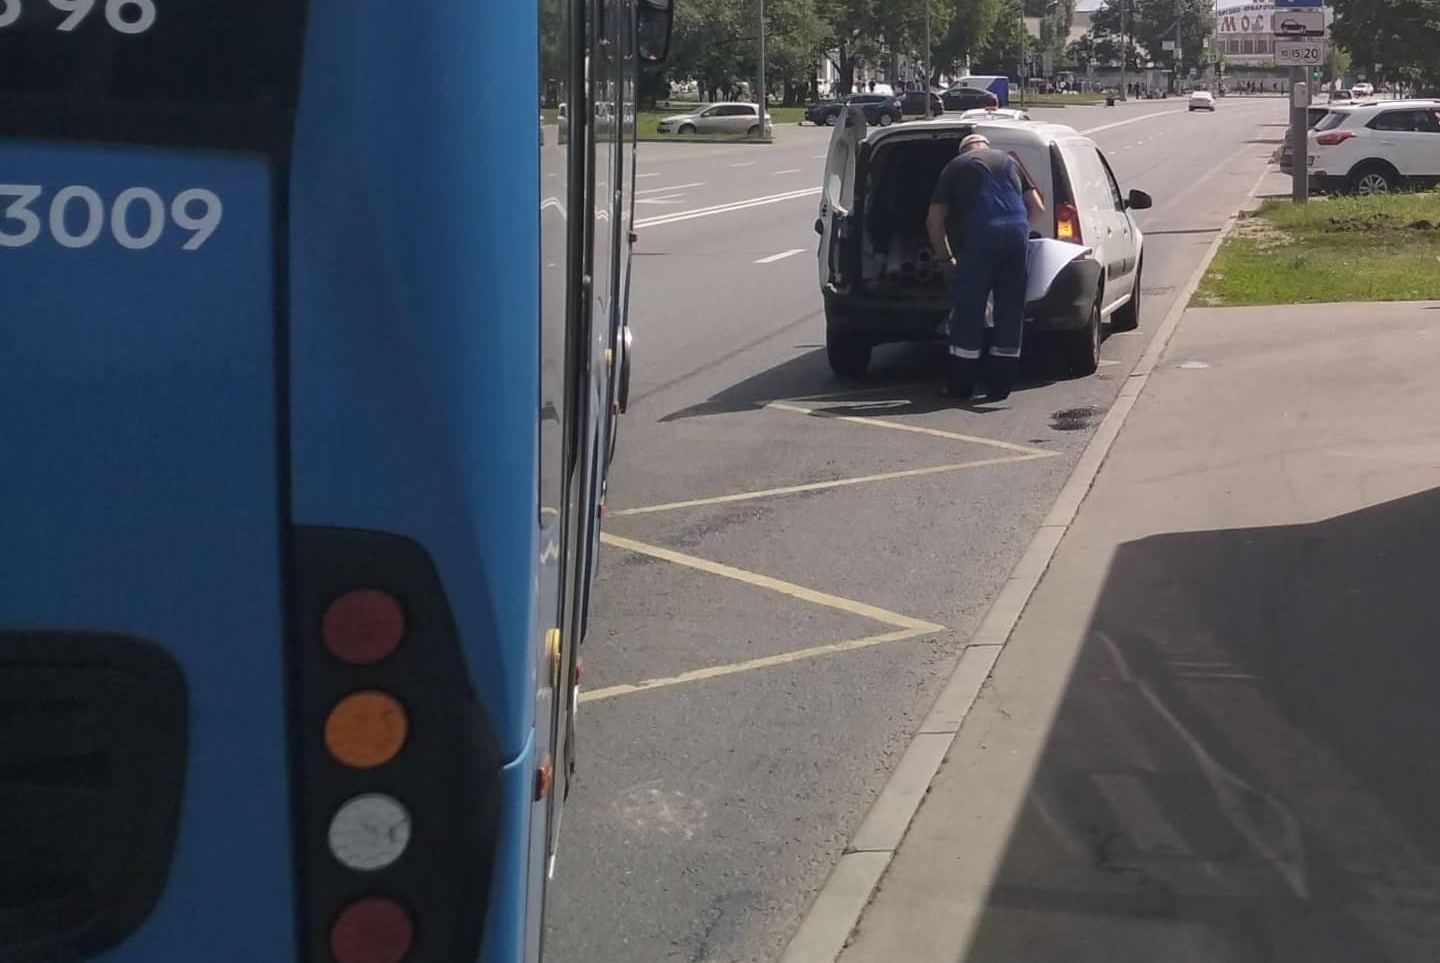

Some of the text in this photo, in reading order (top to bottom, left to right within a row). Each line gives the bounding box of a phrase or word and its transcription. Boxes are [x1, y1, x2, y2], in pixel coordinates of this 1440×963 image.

[1291, 49, 1300, 58] 15
[1304, 48, 1319, 59] 20
[0, 184, 223, 250] 3009
